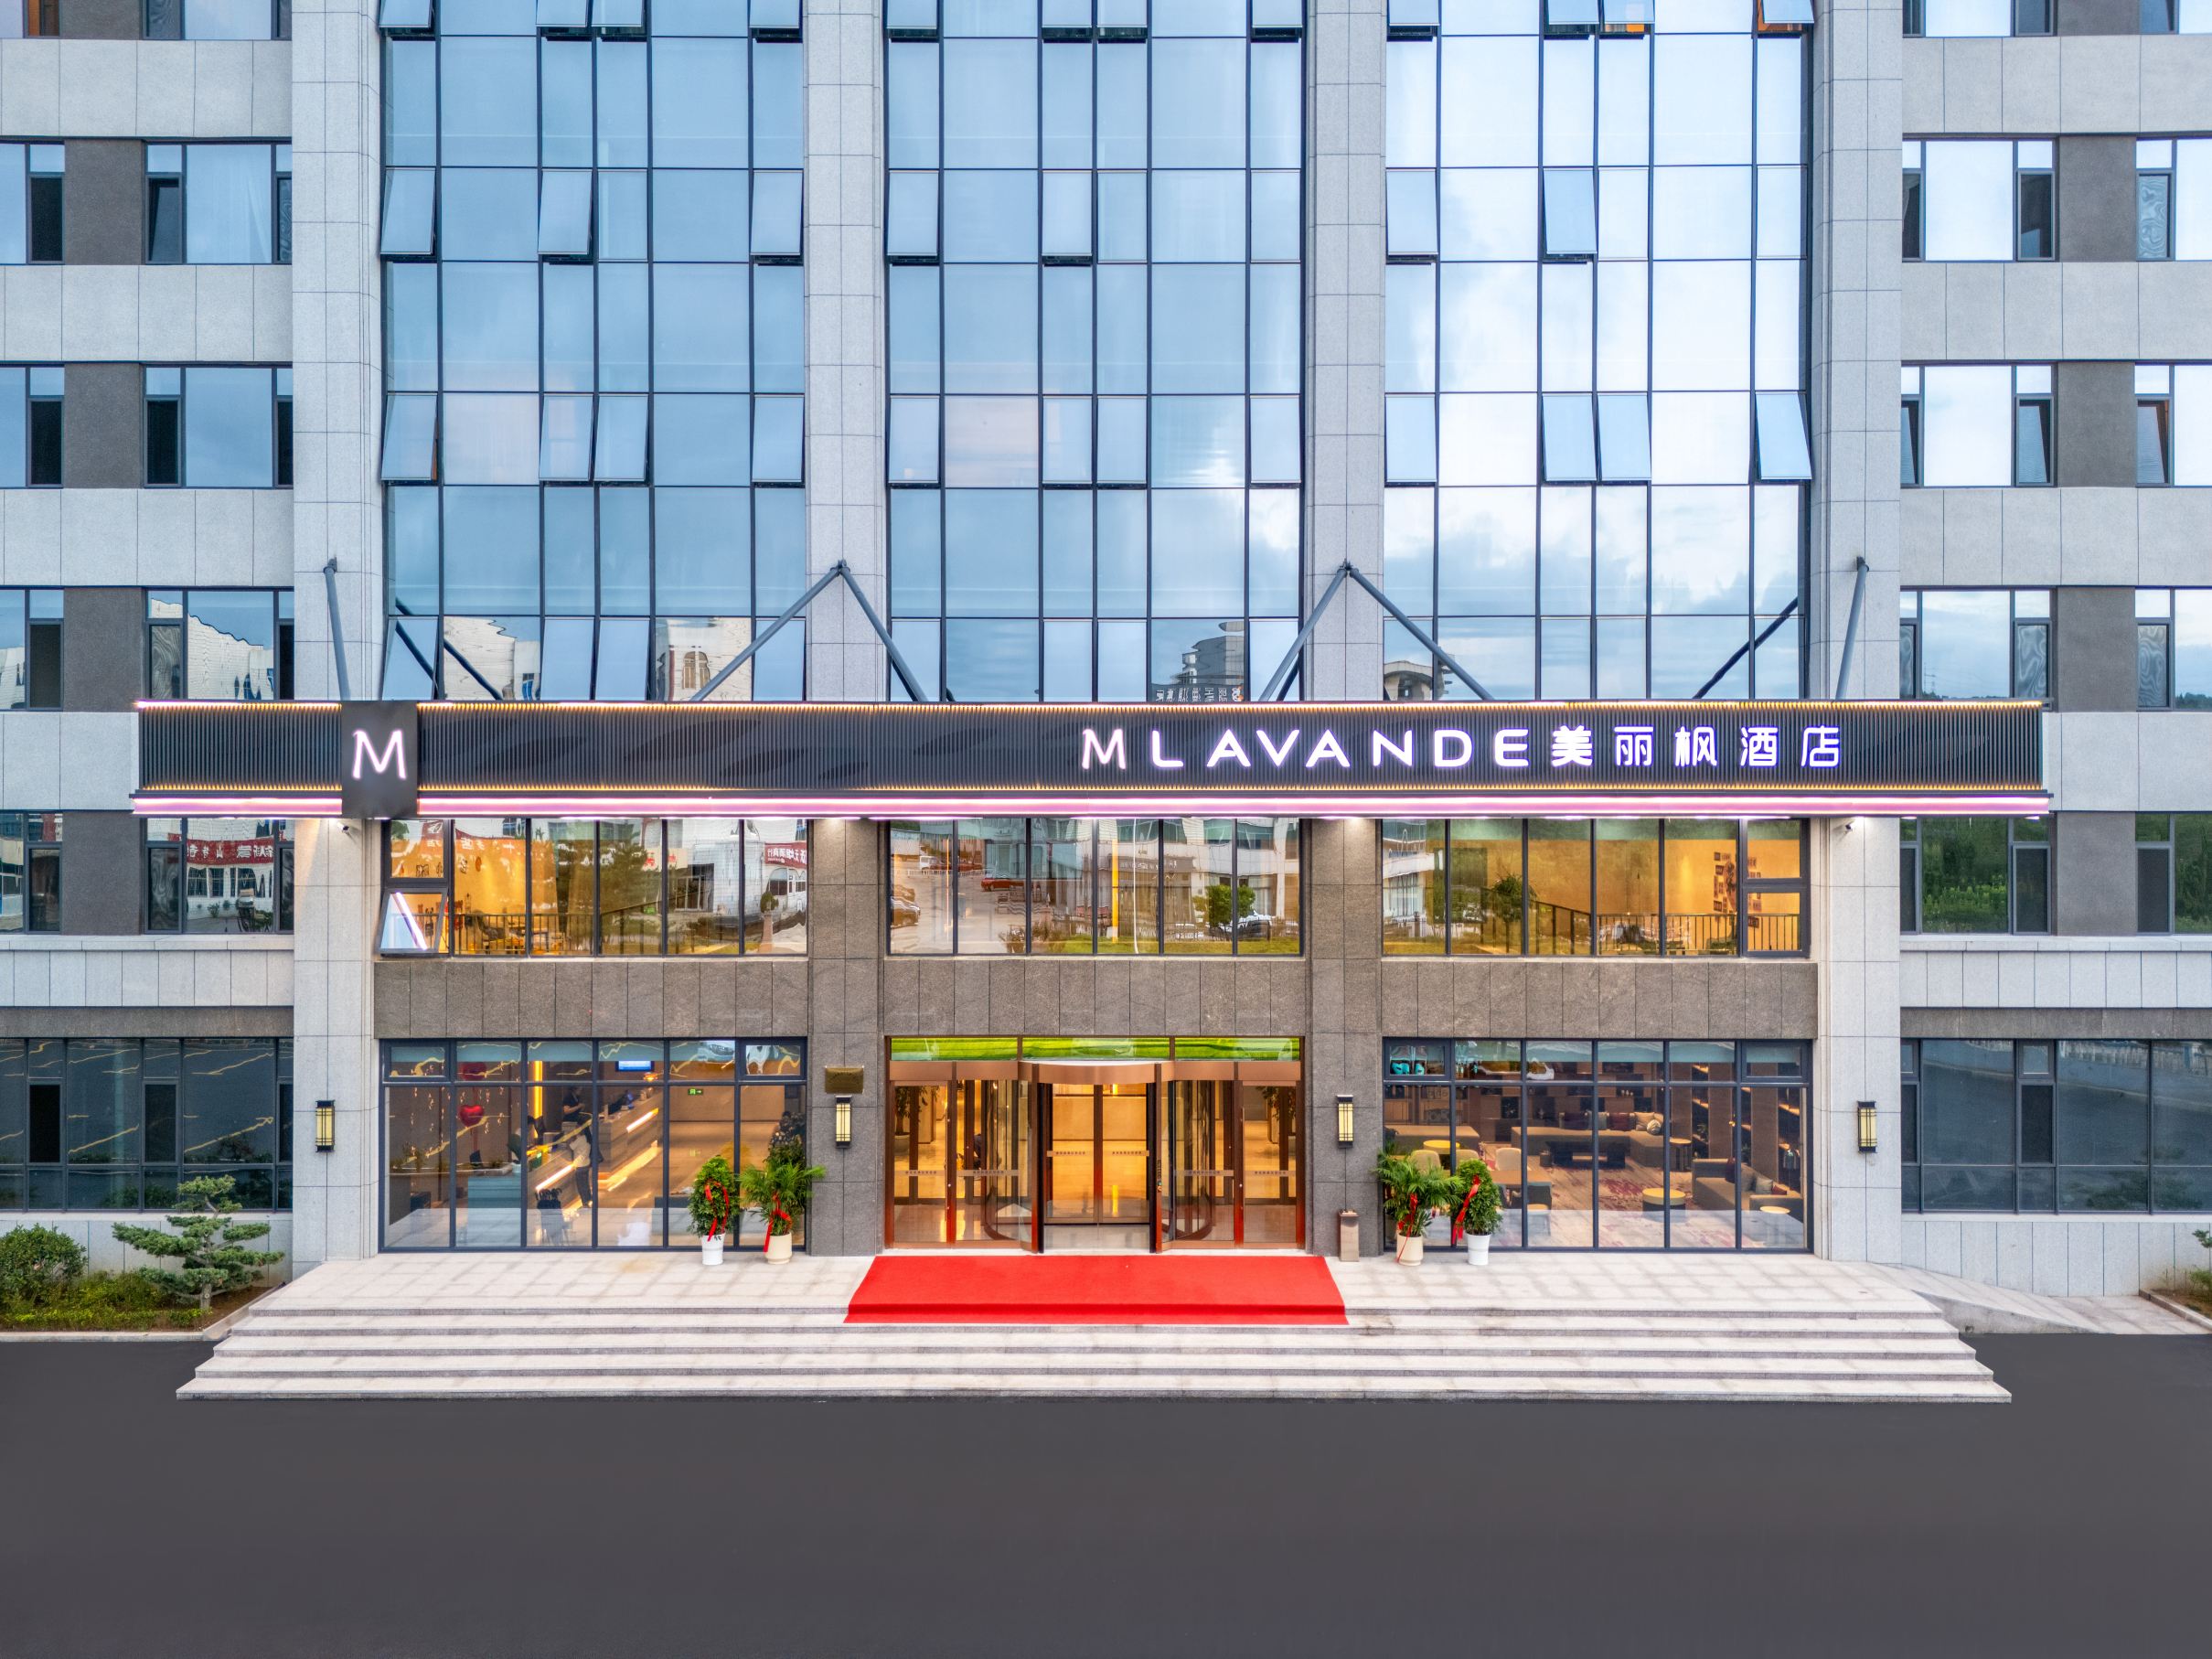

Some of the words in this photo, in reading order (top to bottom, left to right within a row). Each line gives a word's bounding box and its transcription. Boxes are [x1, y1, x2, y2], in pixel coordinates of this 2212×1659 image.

[352, 729, 406, 779] M
[1551, 724, 1841, 768] 美丽枫酒店
